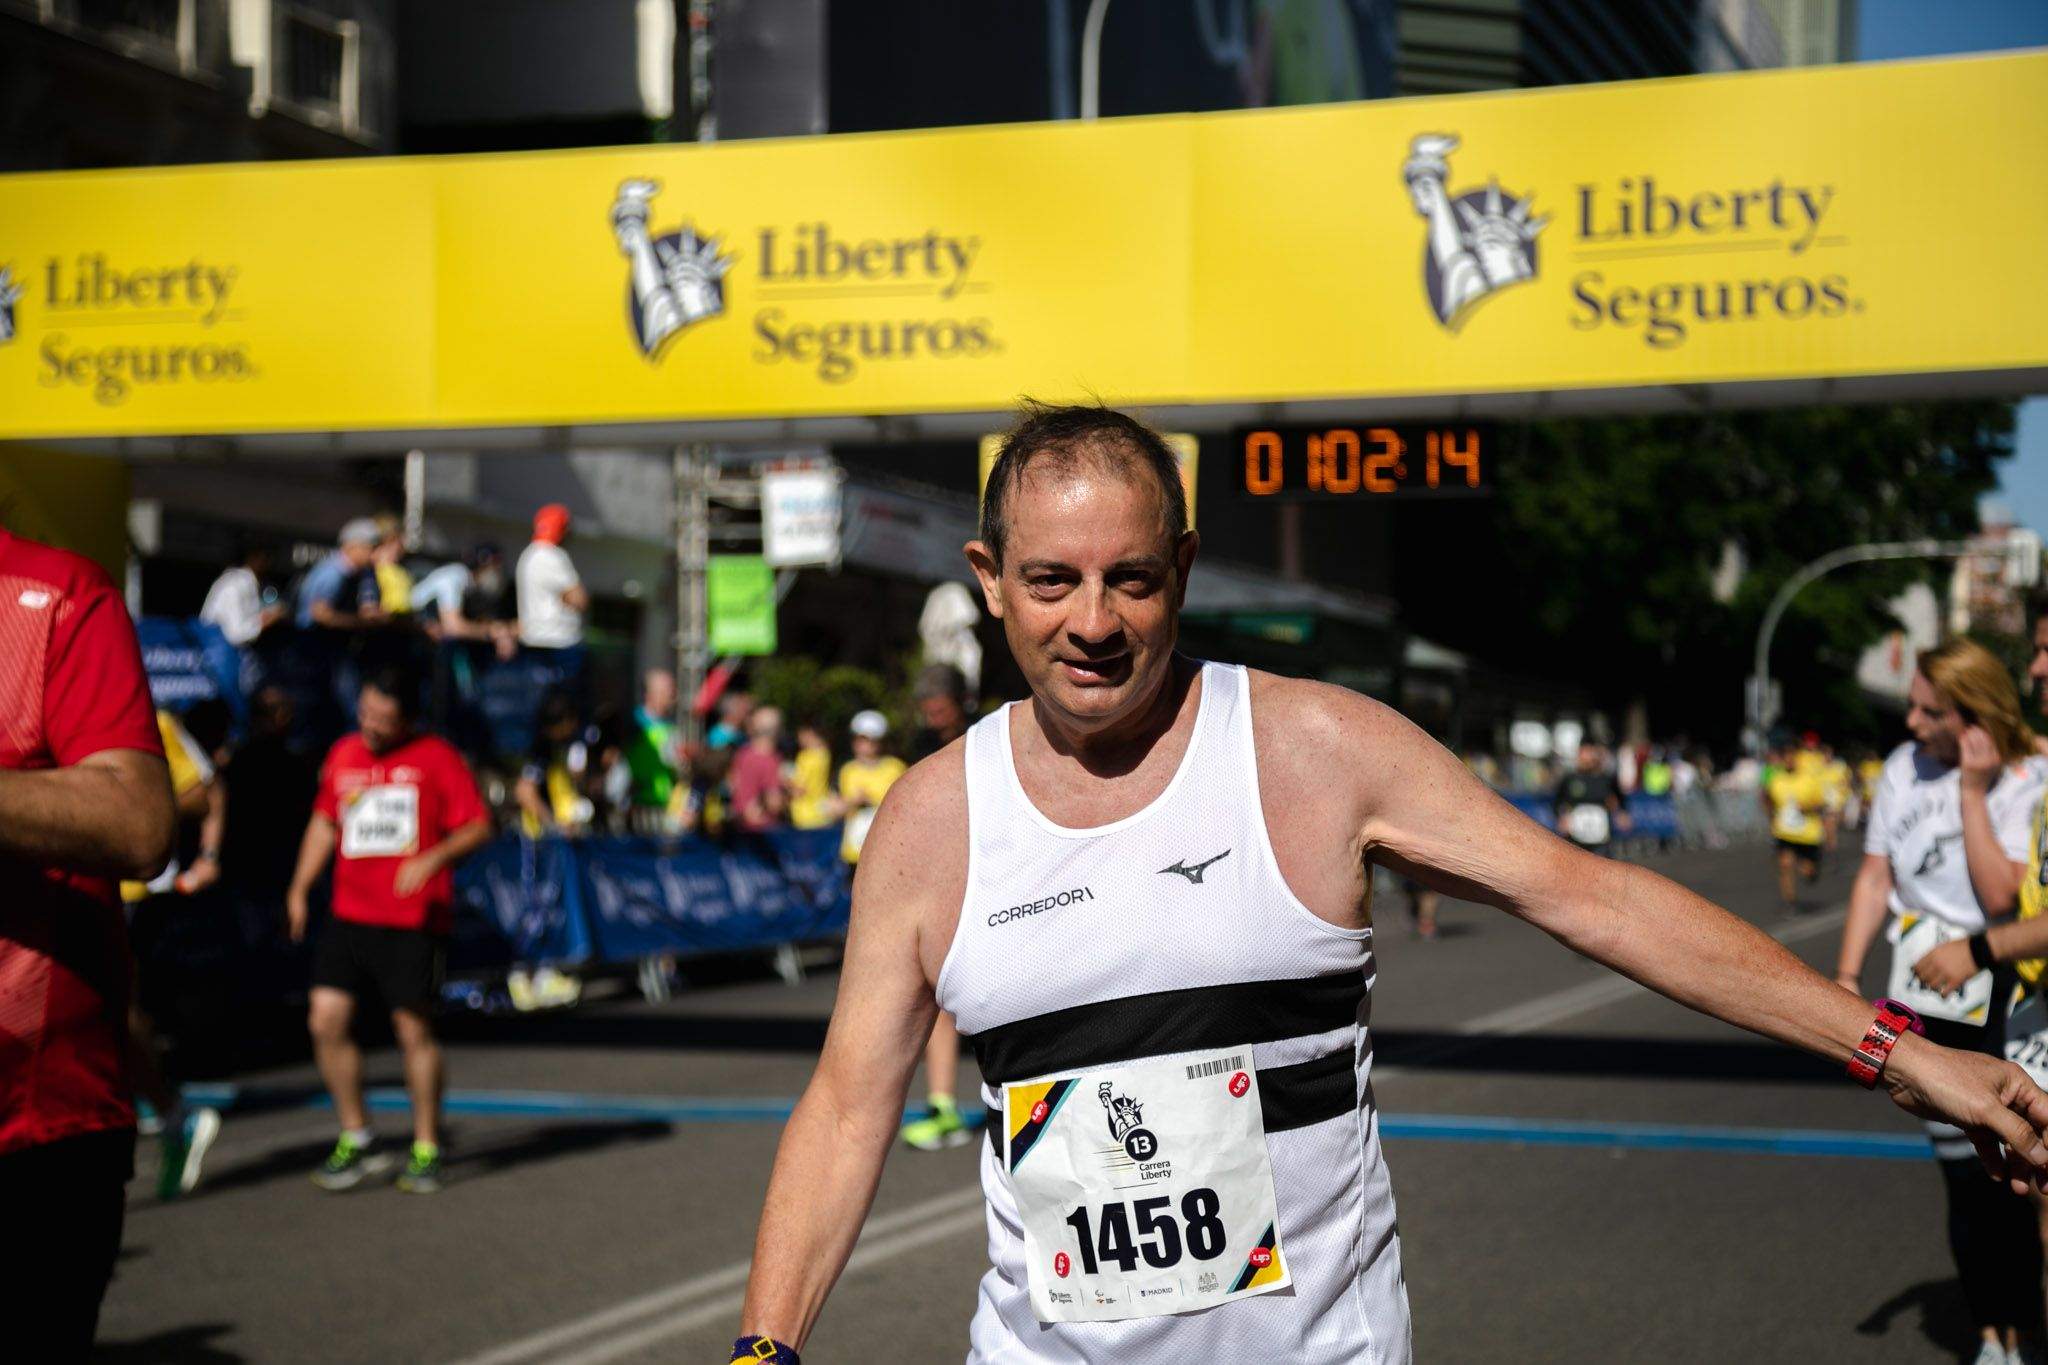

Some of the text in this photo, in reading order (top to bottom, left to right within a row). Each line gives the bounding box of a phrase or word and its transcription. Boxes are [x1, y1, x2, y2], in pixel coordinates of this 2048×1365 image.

[1575, 175, 1834, 256] Liberty
[755, 221, 983, 300] Liberty
[43, 251, 240, 328] Liberty
[1130, 1136, 1152, 1155] 13
[1139, 1161, 1171, 1171] Carrera
[1140, 1170, 1172, 1181] Liberty
[1066, 1187, 1227, 1275] 1458
[1148, 1287, 1174, 1296] MADRID
